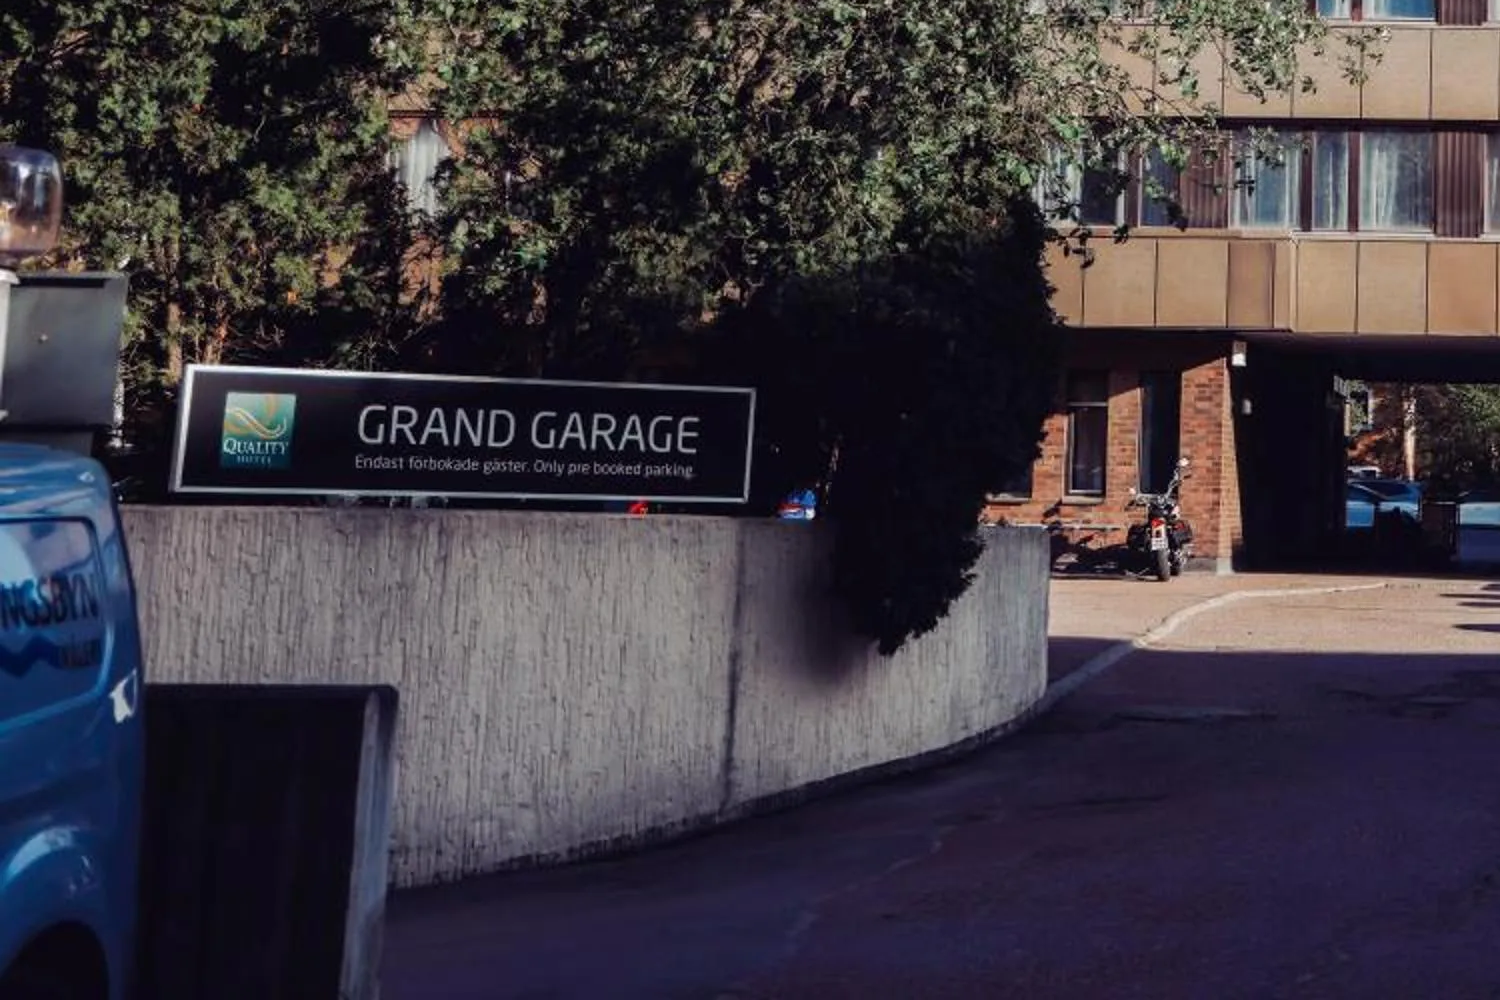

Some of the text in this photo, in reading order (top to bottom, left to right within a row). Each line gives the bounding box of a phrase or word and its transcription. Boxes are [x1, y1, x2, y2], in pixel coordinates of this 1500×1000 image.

[357, 404, 700, 454] GRAND GARAGE
[223, 437, 289, 455] QUALITY
[354, 454, 404, 470] Endast
[408, 455, 480, 471] förbokade
[482, 457, 530, 475] gäster.
[533, 459, 565, 477] Only
[567, 462, 591, 476] pre
[592, 460, 641, 476] booked
